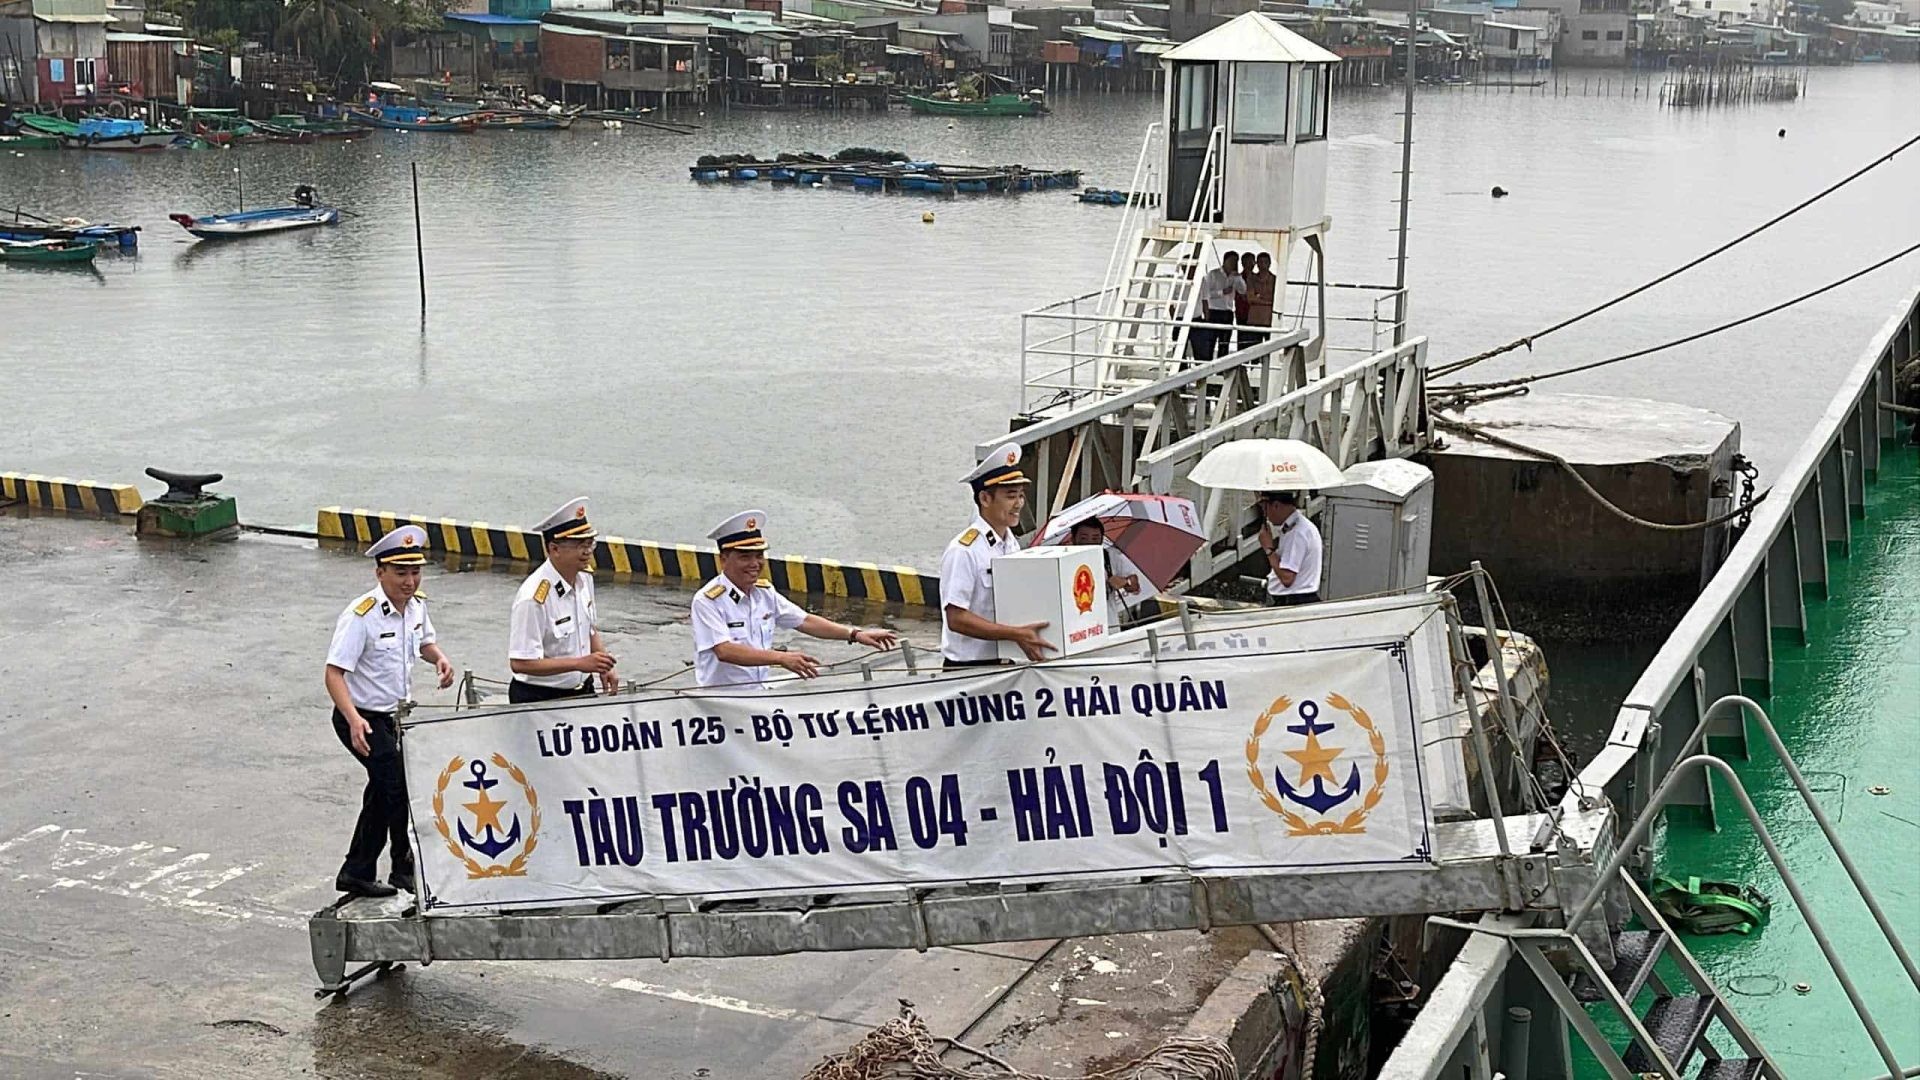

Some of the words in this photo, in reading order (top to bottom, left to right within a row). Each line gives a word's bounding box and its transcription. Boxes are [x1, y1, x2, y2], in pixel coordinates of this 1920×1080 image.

[1271, 462, 1297, 473] Joie
[537, 722, 573, 757] LỮ
[581, 717, 663, 755] ĐOÀN
[672, 716, 726, 747] 125
[751, 709, 793, 747] BỘ
[798, 709, 840, 739] TƯ
[846, 703, 930, 740] LỆNH
[935, 691, 1026, 727] VÙNG
[1035, 687, 1057, 718] 2
[1063, 676, 1121, 717] HẢI
[1130, 675, 1228, 717] QUÂN
[563, 787, 644, 867] TÀU
[651, 775, 830, 863] TRƯỜNG
[837, 780, 899, 855] SA
[905, 774, 968, 850] 04
[980, 807, 997, 821] -
[1007, 747, 1094, 842] HẢI
[1102, 749, 1189, 849] ĐỘI
[1198, 759, 1229, 833] 1
